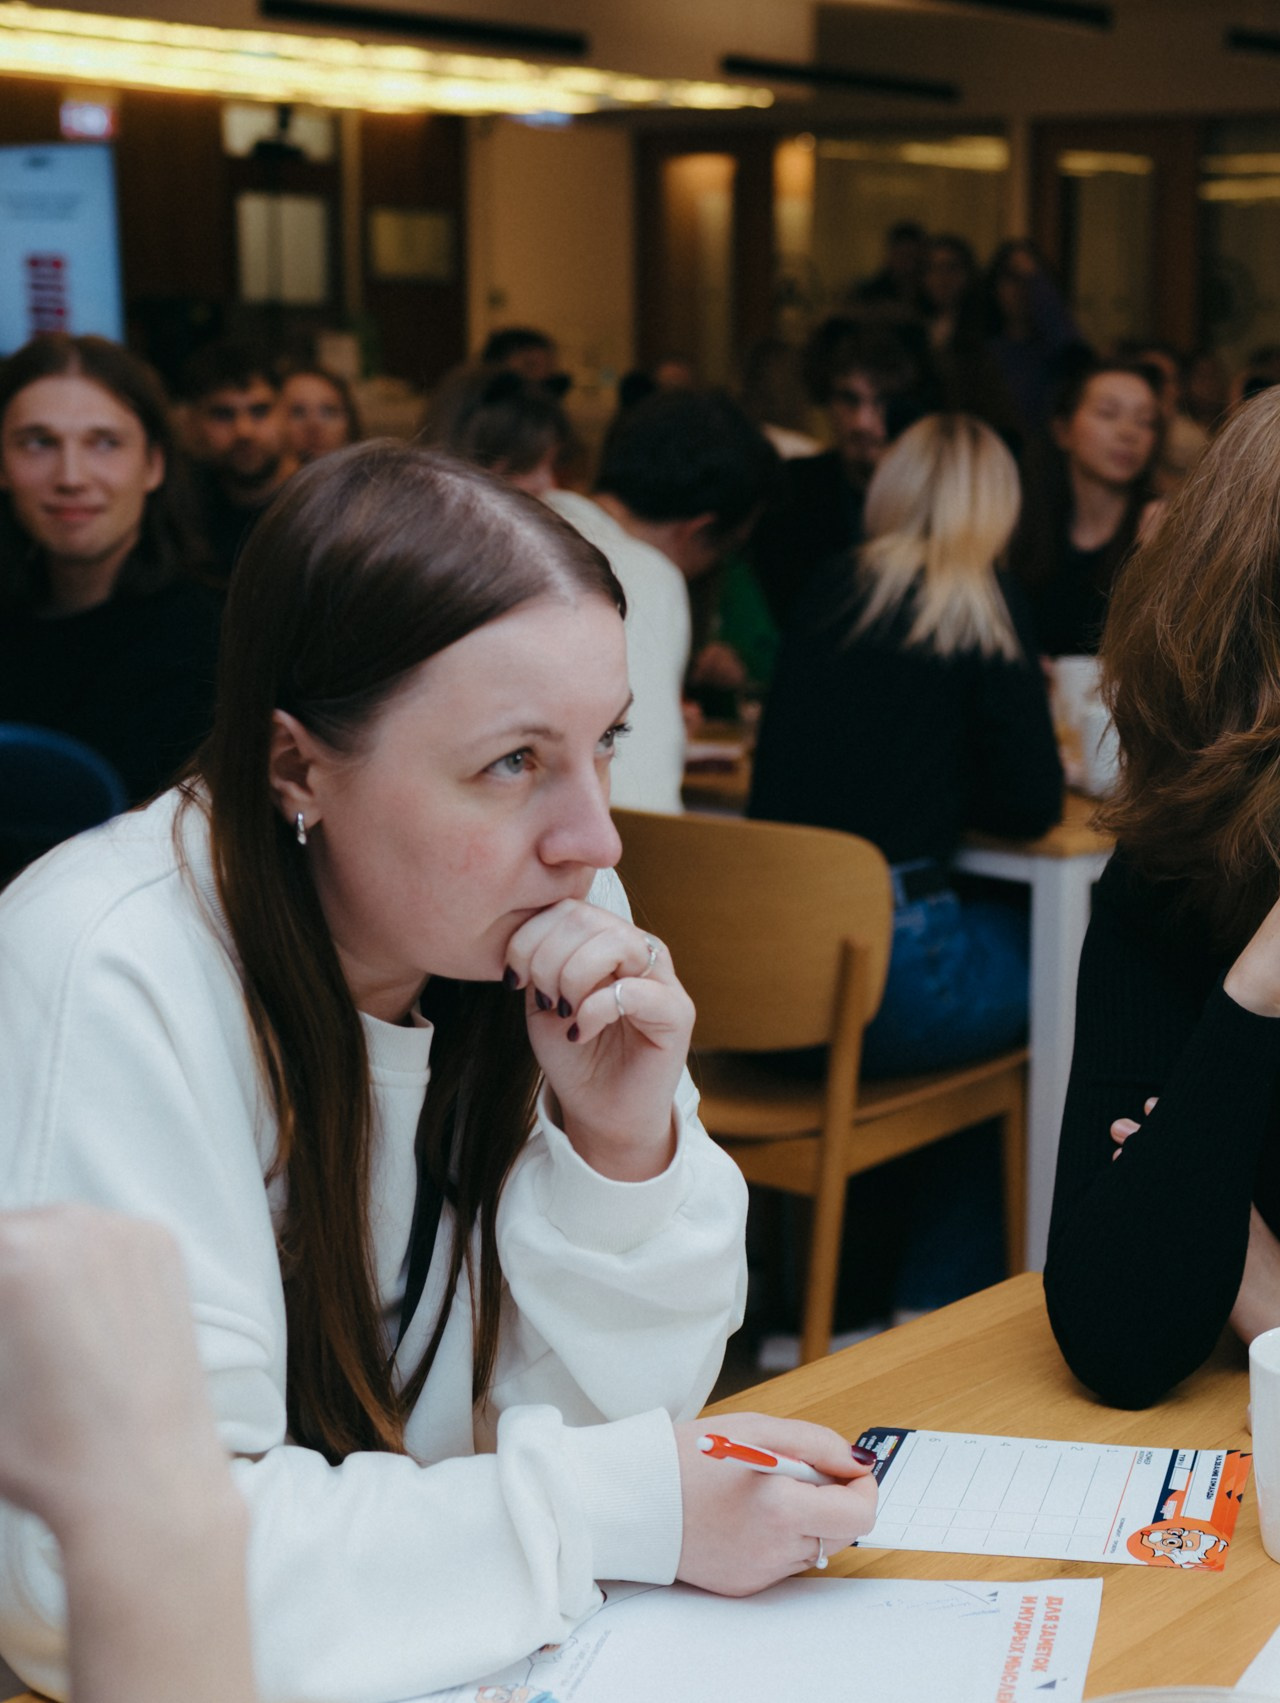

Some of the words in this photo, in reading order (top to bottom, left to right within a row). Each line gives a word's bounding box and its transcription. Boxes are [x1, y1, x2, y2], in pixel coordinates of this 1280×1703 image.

[1021, 1596, 1038, 1604] И
[1043, 1595, 1064, 1622] ДЛЯ
[1008, 1605, 1035, 1653] МУДРЫХ
[1030, 1623, 1058, 1672] ЗАМЕТОК
